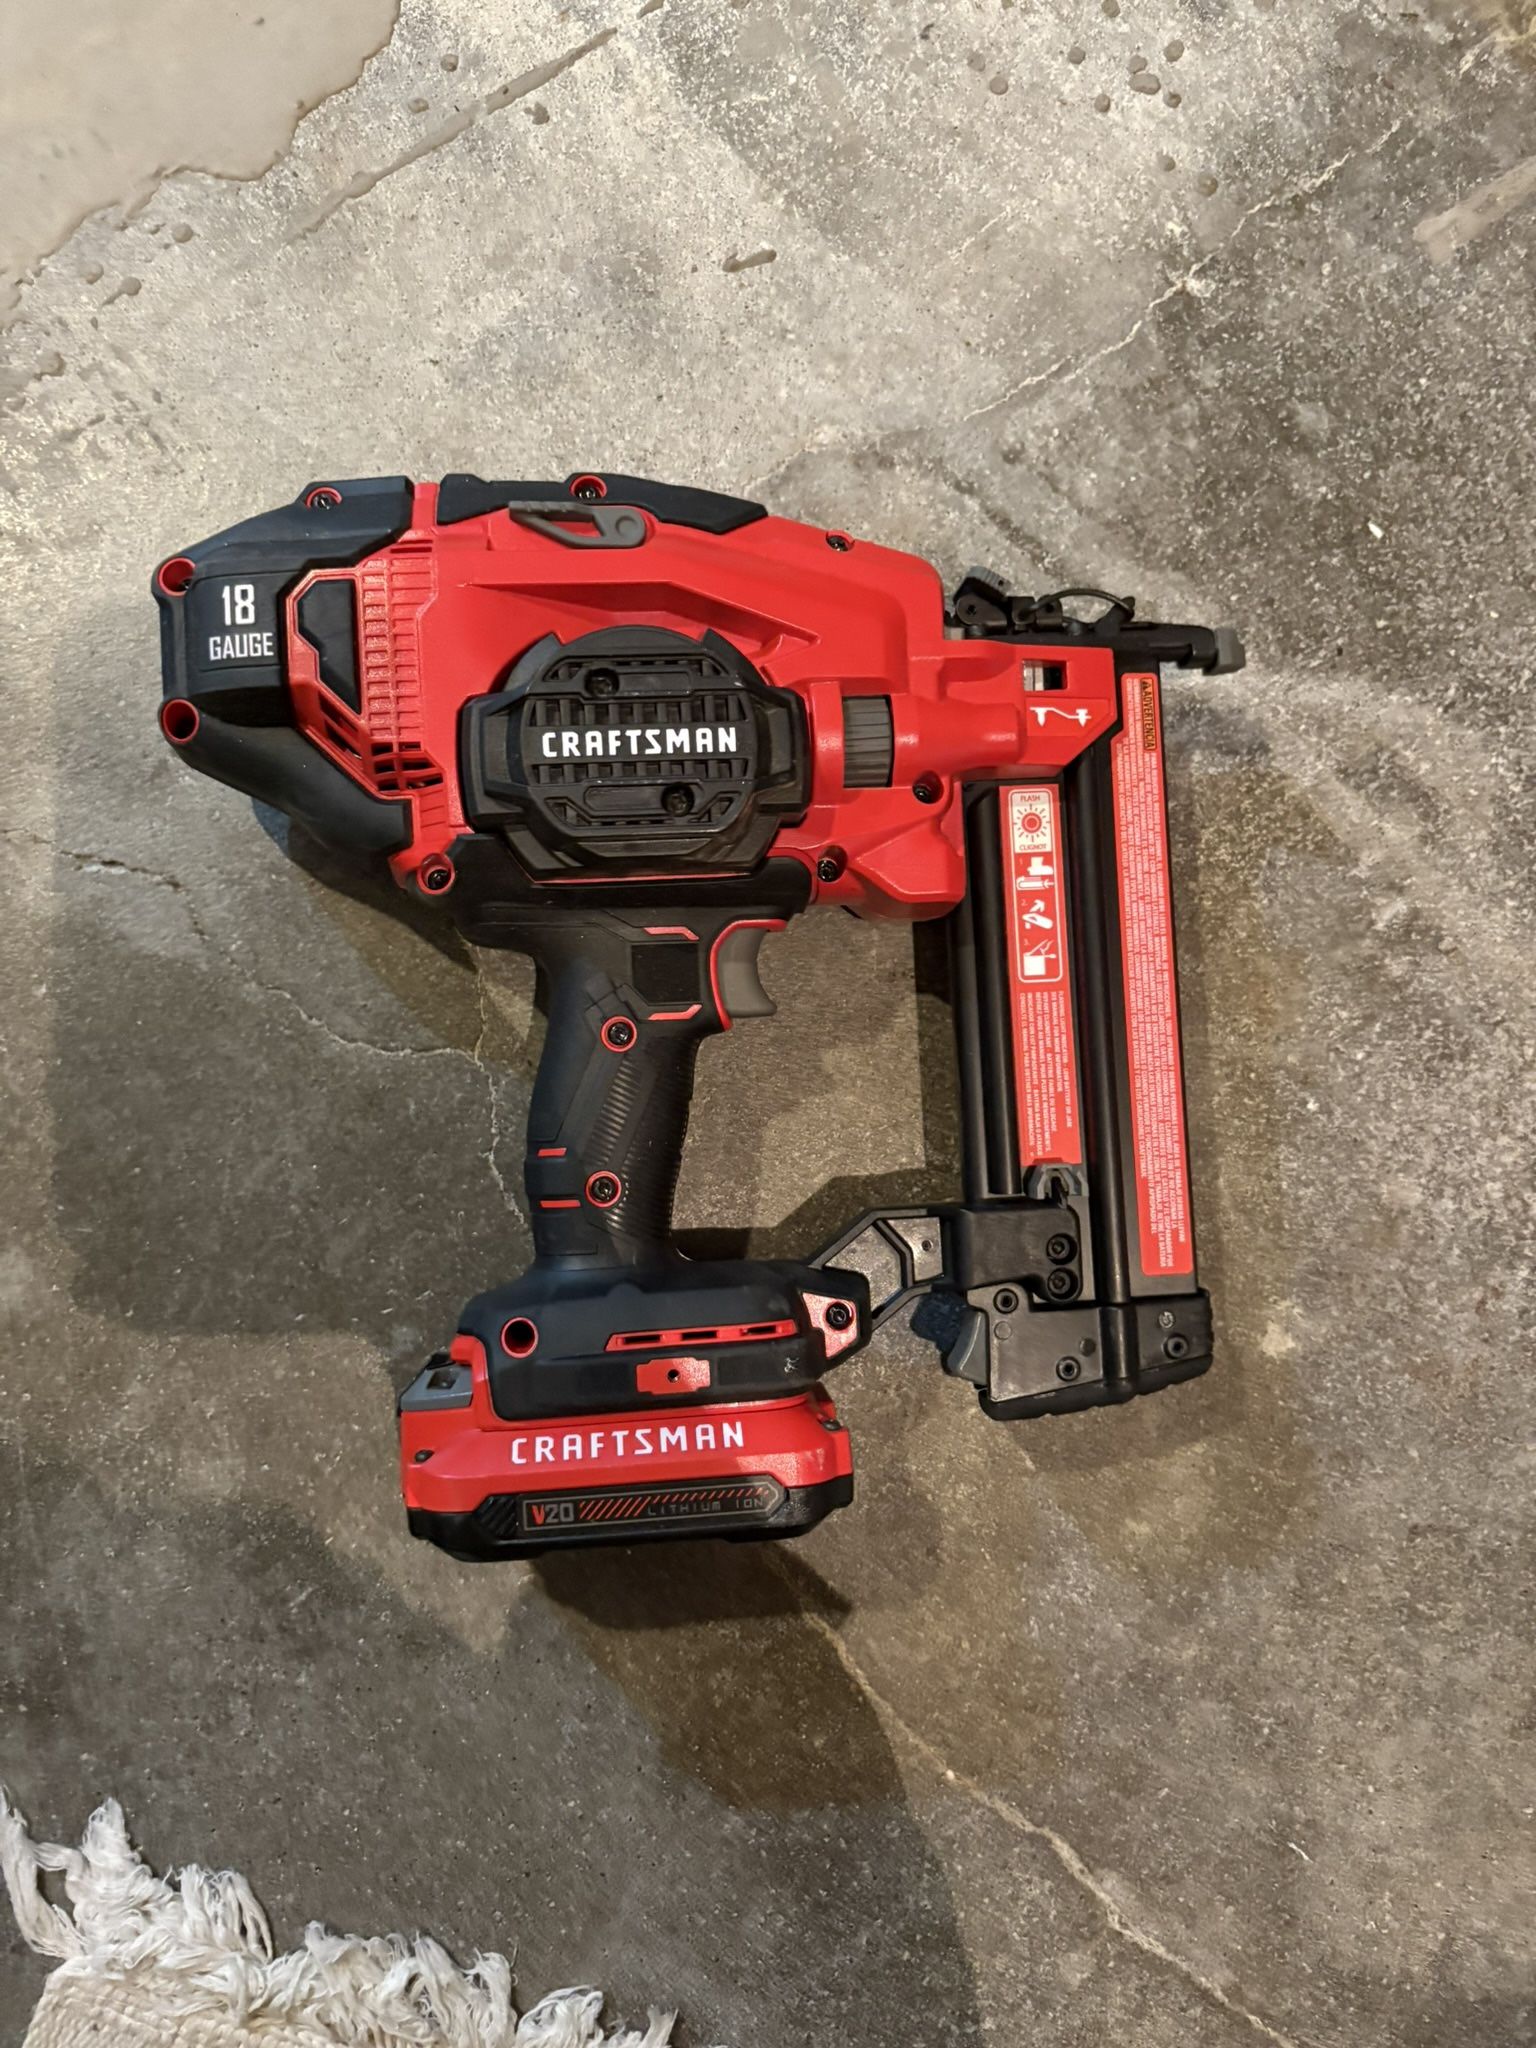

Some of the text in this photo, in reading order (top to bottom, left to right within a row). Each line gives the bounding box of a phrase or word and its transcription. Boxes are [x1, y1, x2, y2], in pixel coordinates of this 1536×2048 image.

[222, 584, 255, 625] 18
[209, 632, 274, 661] GAUGE
[1142, 690, 1154, 747] ADVERTENCIA
[542, 727, 737, 758] CRAFTSMAN
[511, 1421, 745, 1465] CRAFTSMAN
[531, 1498, 763, 1526] V20 LITHIUM ION
